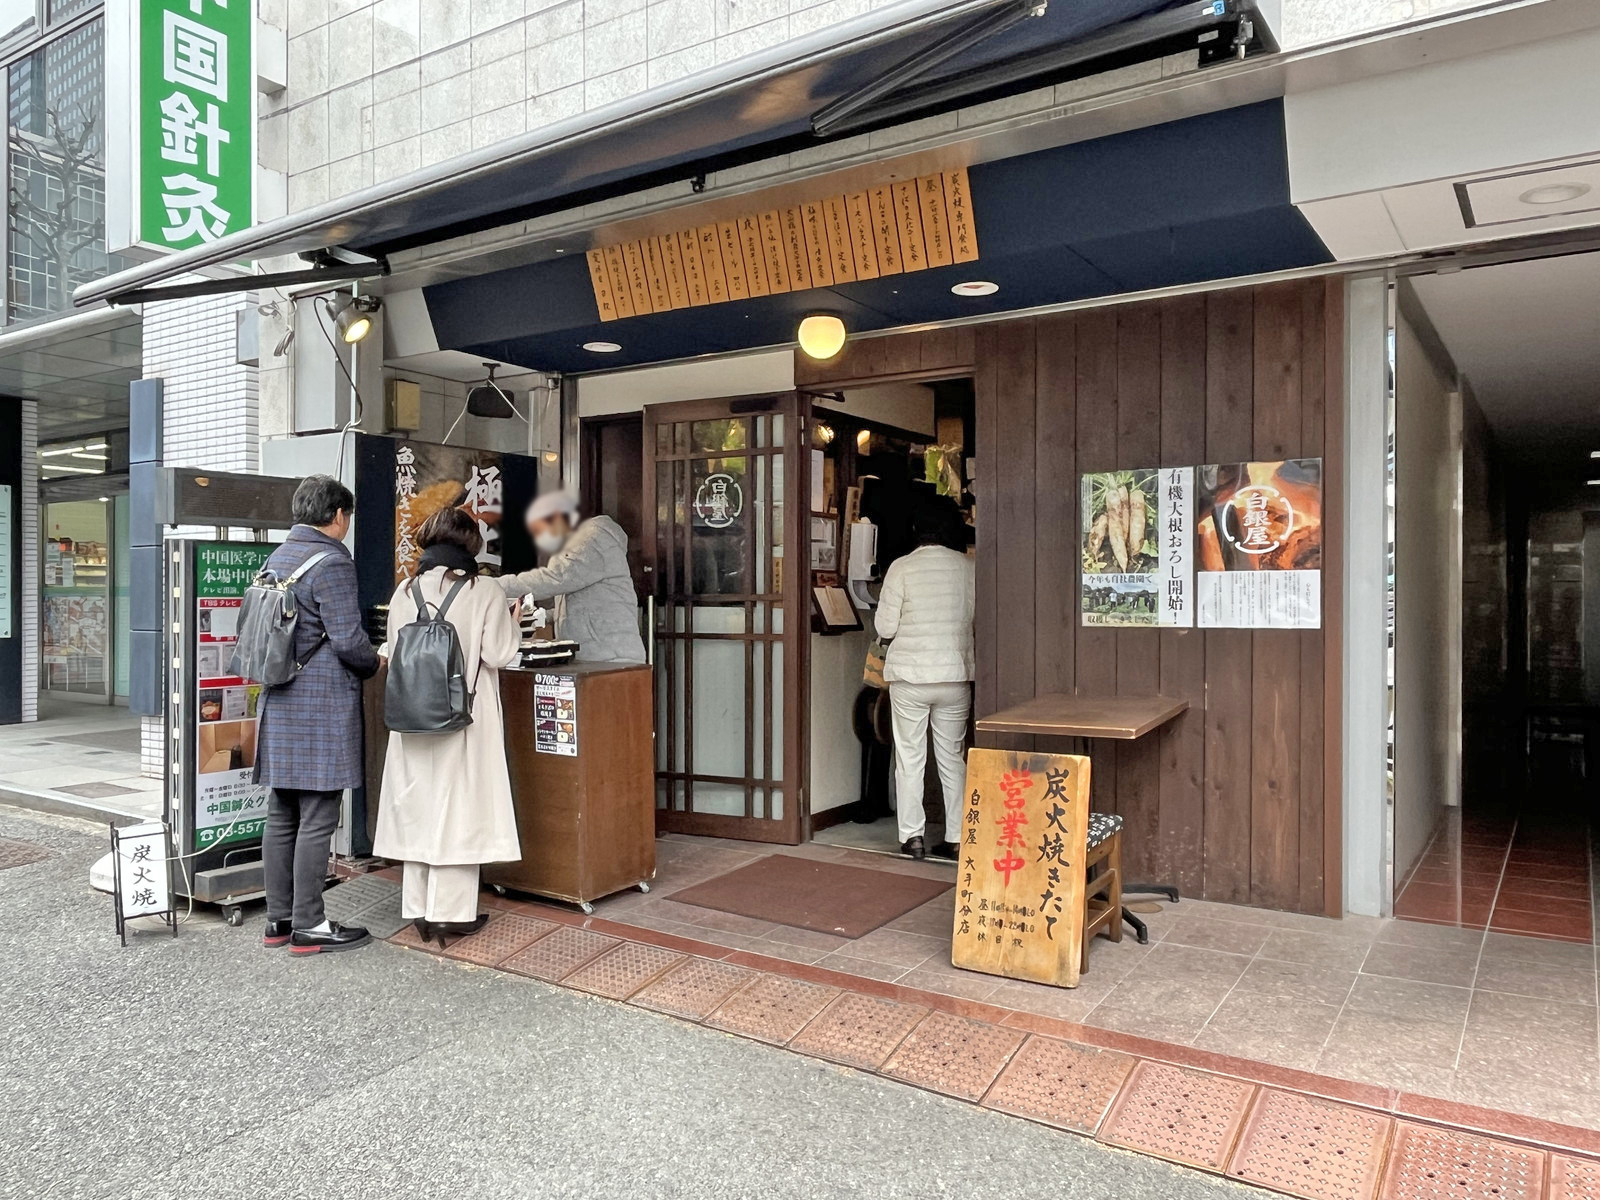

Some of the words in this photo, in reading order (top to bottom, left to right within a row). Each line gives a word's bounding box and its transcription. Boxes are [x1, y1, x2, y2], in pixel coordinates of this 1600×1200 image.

[160, 0, 231, 243] 国針灸
[464, 465, 502, 566] 極上
[1242, 492, 1272, 545] 白銀屋
[964, 789, 981, 846] 白銀屋
[993, 768, 1034, 889] 営業中
[1036, 767, 1070, 941] 炭火焼きたて
[131, 844, 157, 906] 炭火焼
